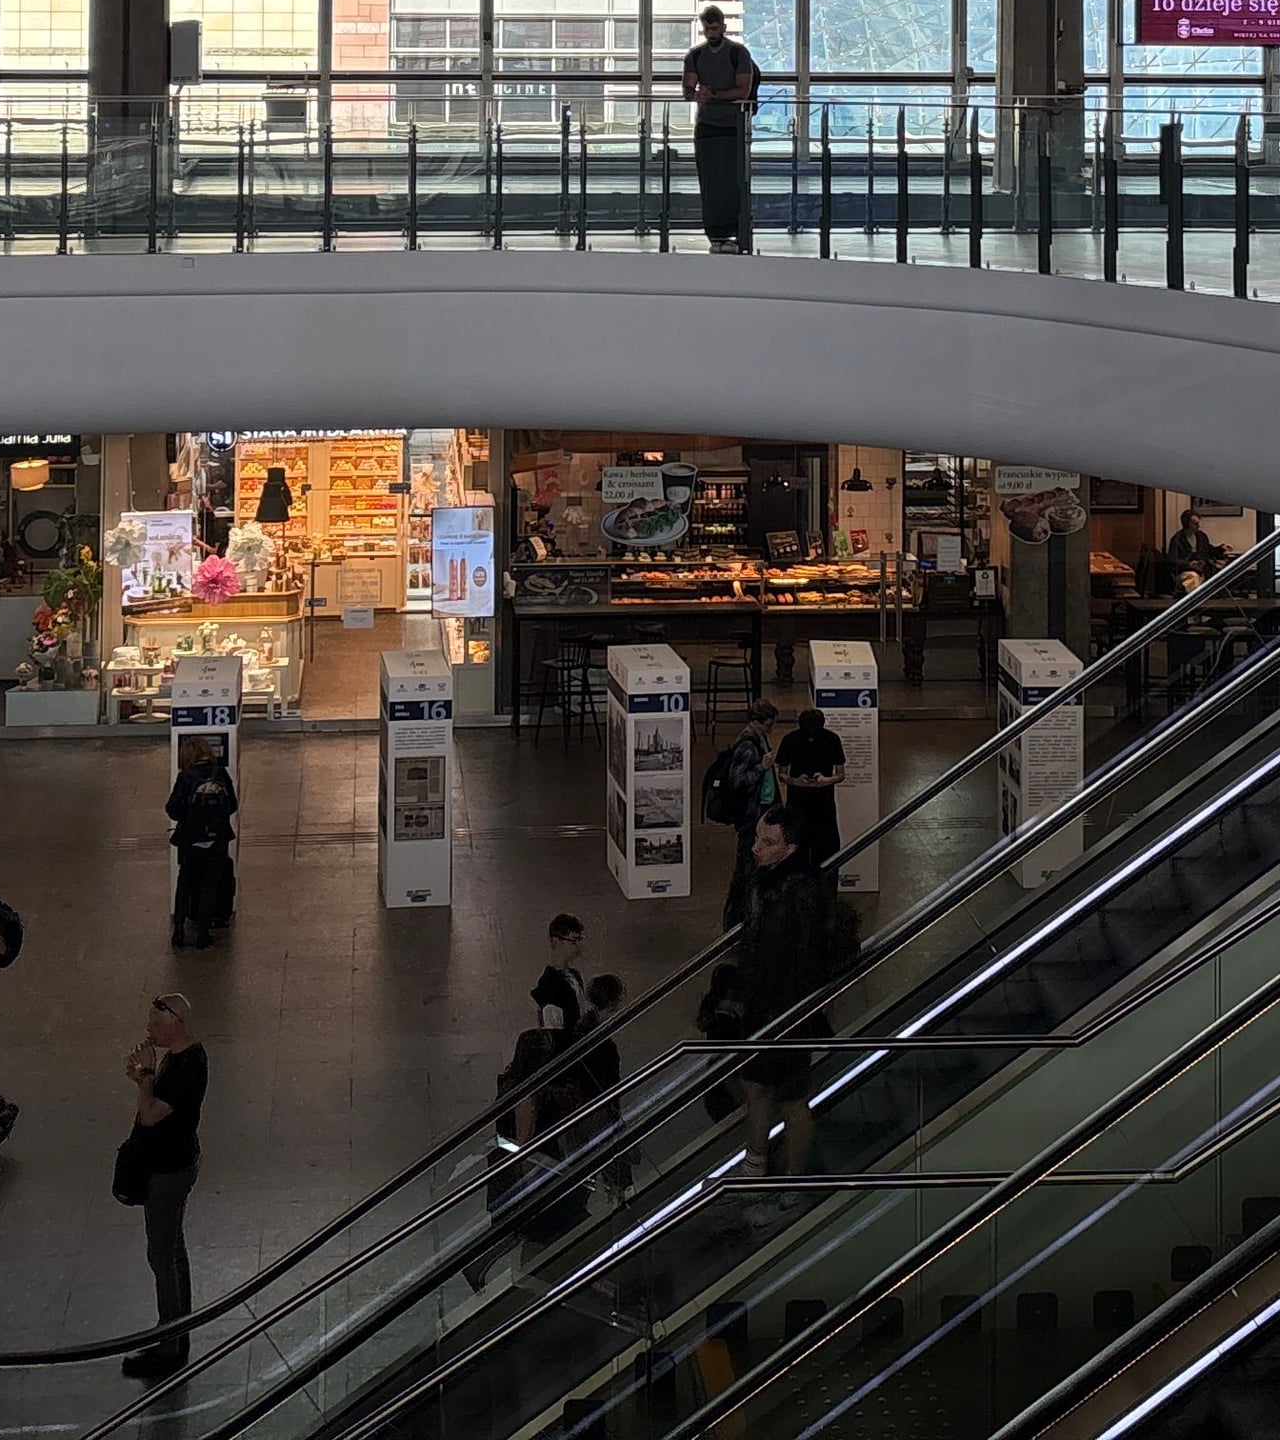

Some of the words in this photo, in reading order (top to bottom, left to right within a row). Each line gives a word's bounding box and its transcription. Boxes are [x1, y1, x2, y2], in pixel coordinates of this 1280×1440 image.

[998, 469, 1043, 479] Francuskie
[618, 479, 655, 488] croissant
[660, 694, 684, 712] 10
[858, 690, 872, 708] 6
[202, 707, 230, 726] 18
[420, 701, 447, 720] 16
